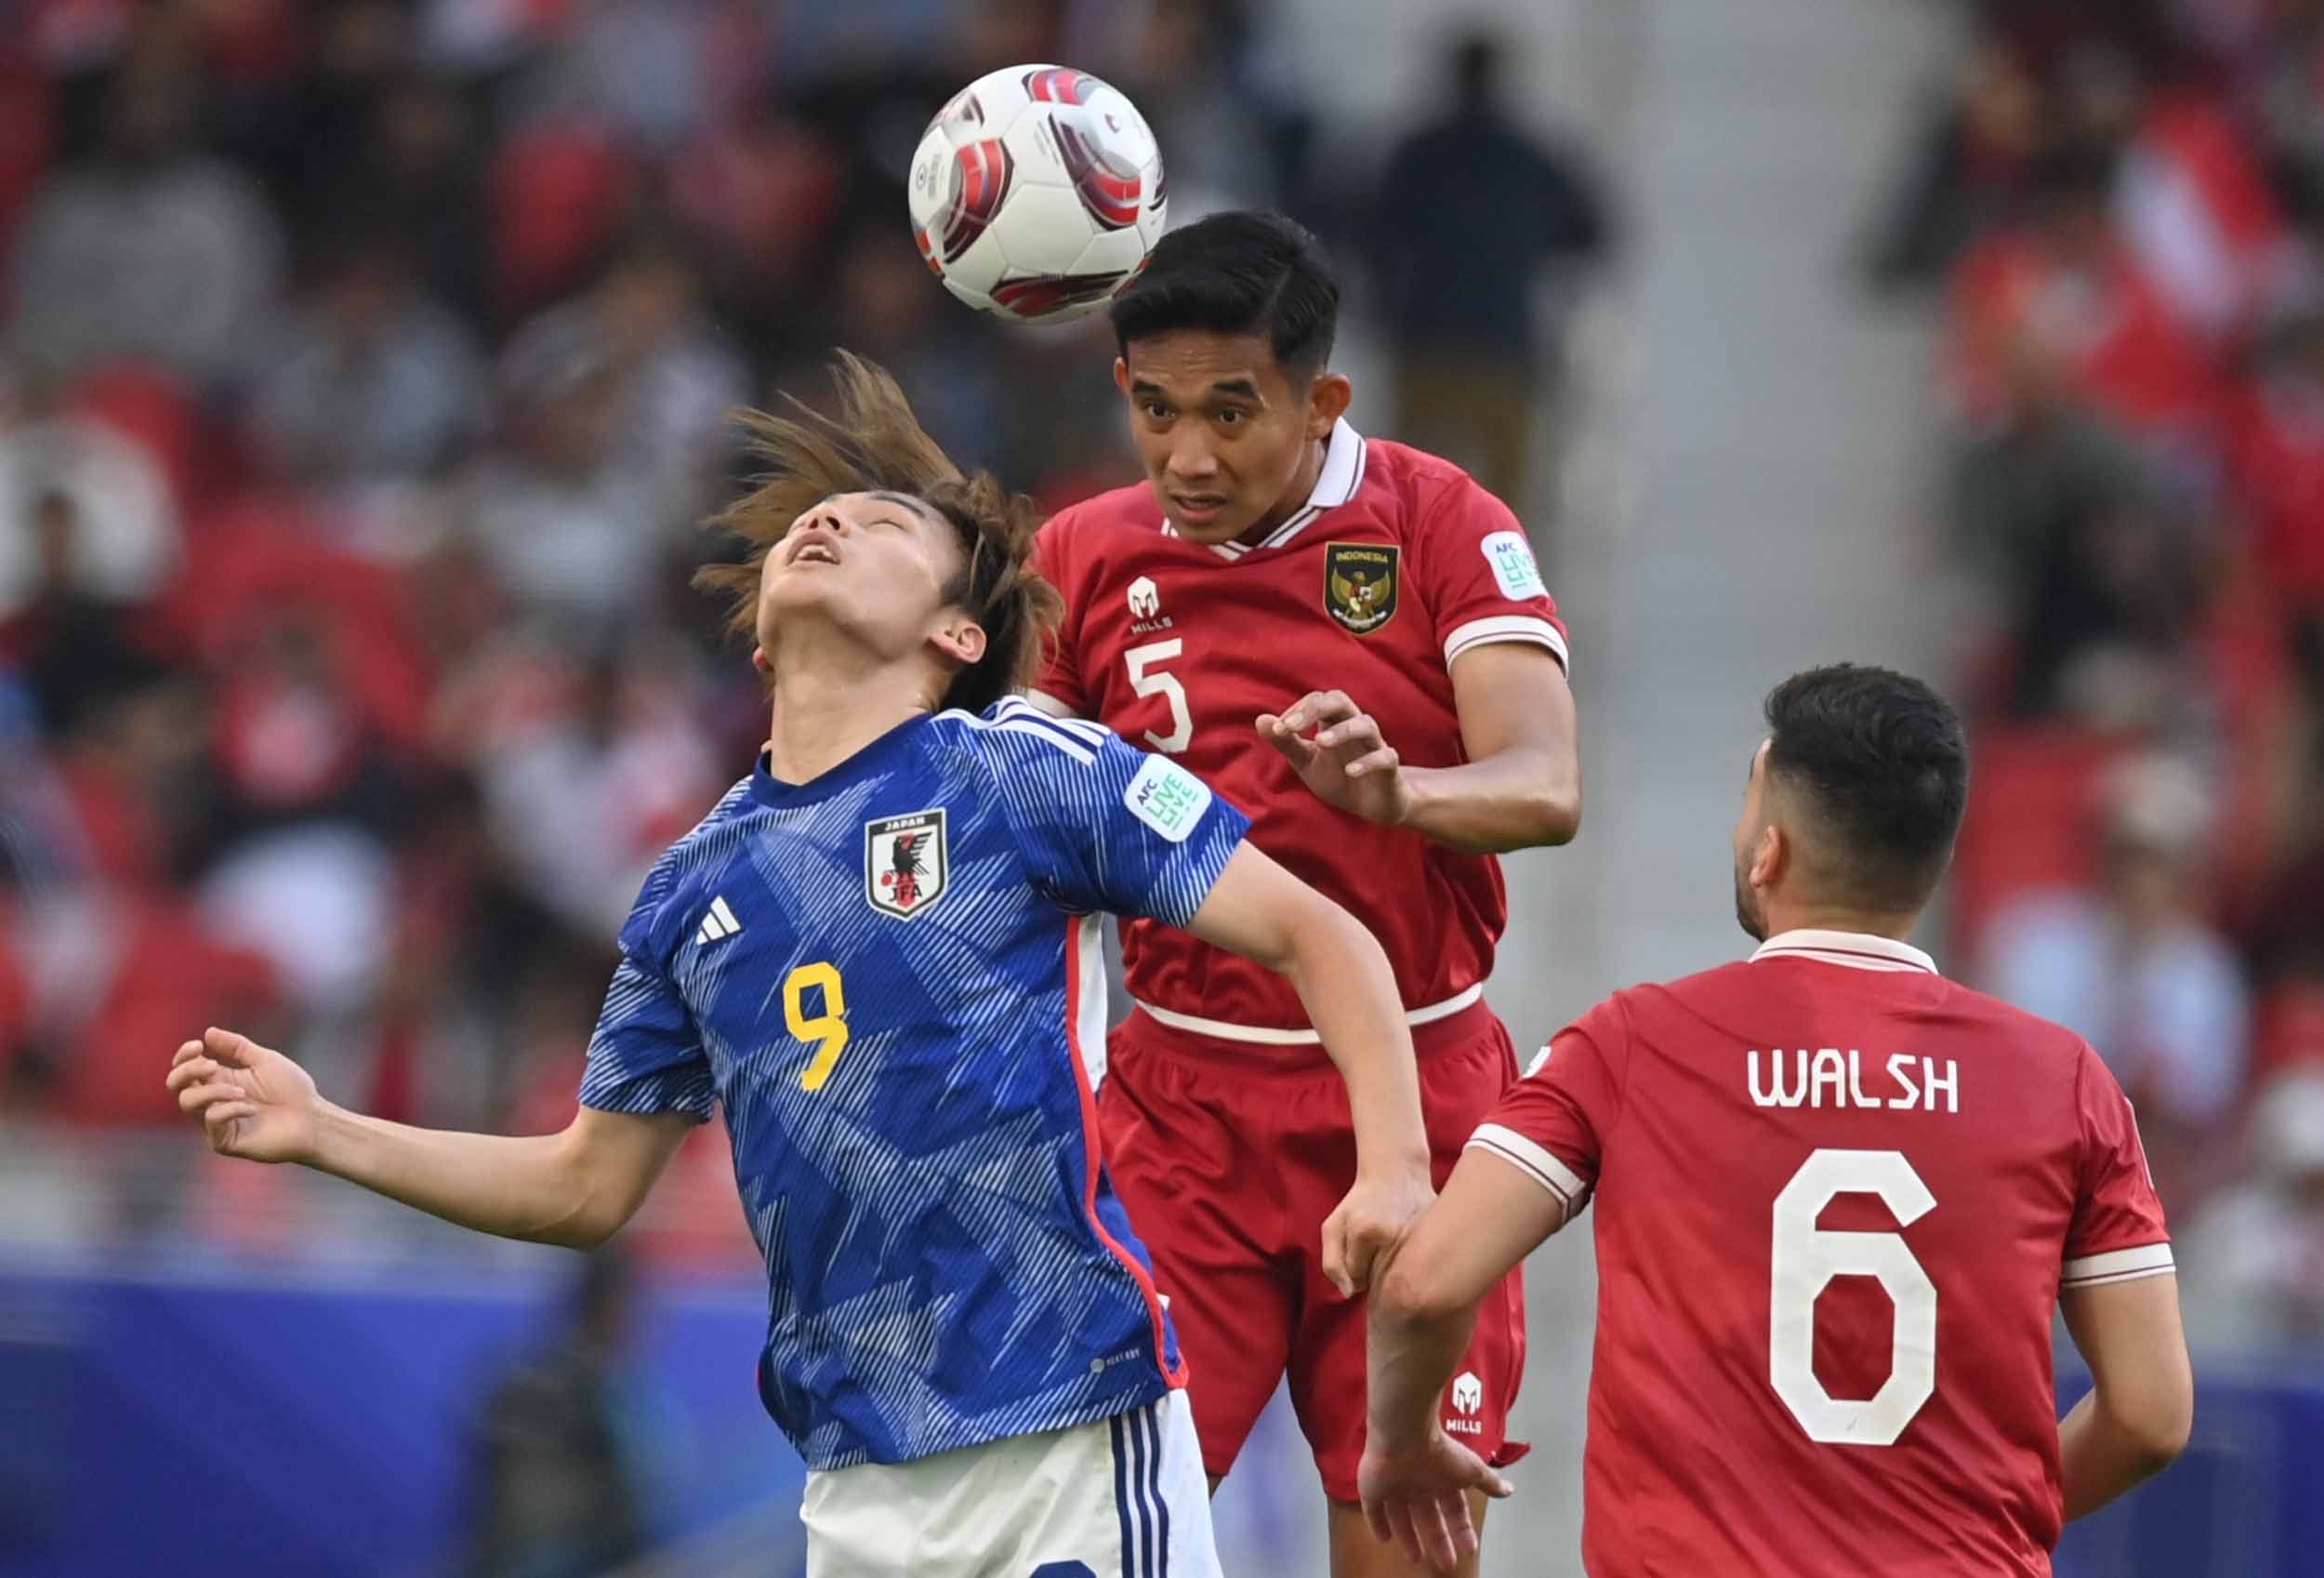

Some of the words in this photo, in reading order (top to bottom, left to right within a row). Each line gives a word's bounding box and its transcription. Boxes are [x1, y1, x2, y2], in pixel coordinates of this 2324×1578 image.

[1131, 617, 1172, 635] MILLS
[1124, 637, 1194, 753] 5
[1137, 778, 1157, 806] AFC
[1145, 774, 1182, 818] LIVE
[885, 816, 925, 831] JAPAN
[783, 961, 849, 1092] 9
[1748, 1048, 1959, 1113] WALSH
[1770, 1147, 1938, 1446] 6
[1446, 1418, 1483, 1435] MILLS
